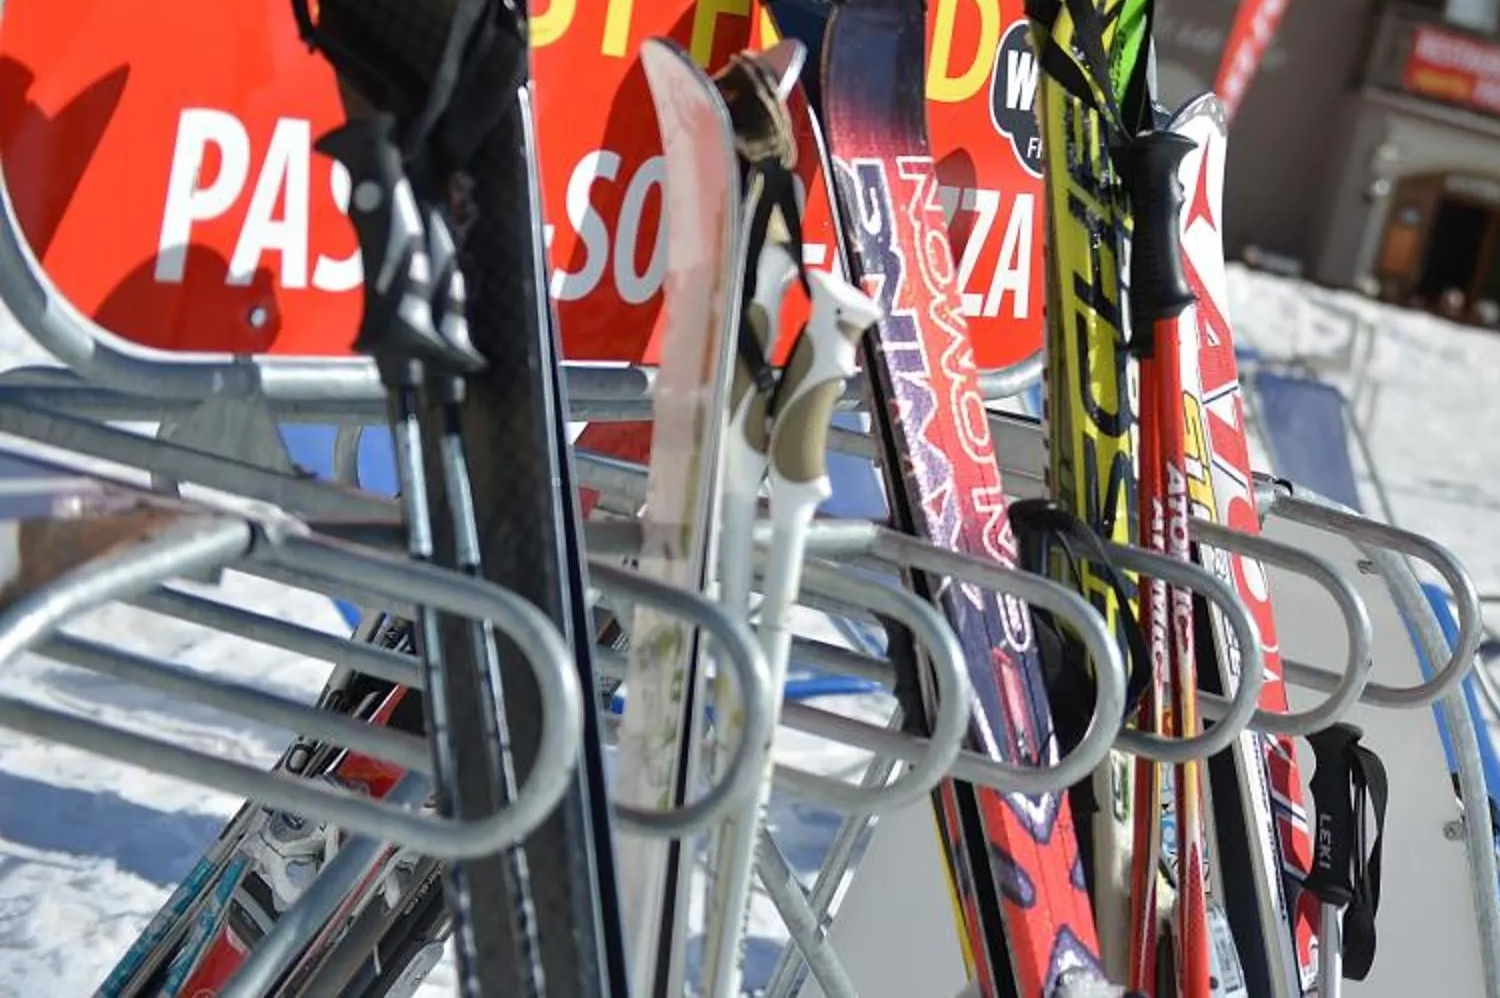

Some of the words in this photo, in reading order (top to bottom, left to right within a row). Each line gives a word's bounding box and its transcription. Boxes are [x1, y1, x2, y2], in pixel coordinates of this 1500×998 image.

[897, 156, 1034, 653] SALOMON
[1151, 498, 1169, 670] ATMIC
[1318, 813, 1332, 870] LEKI
